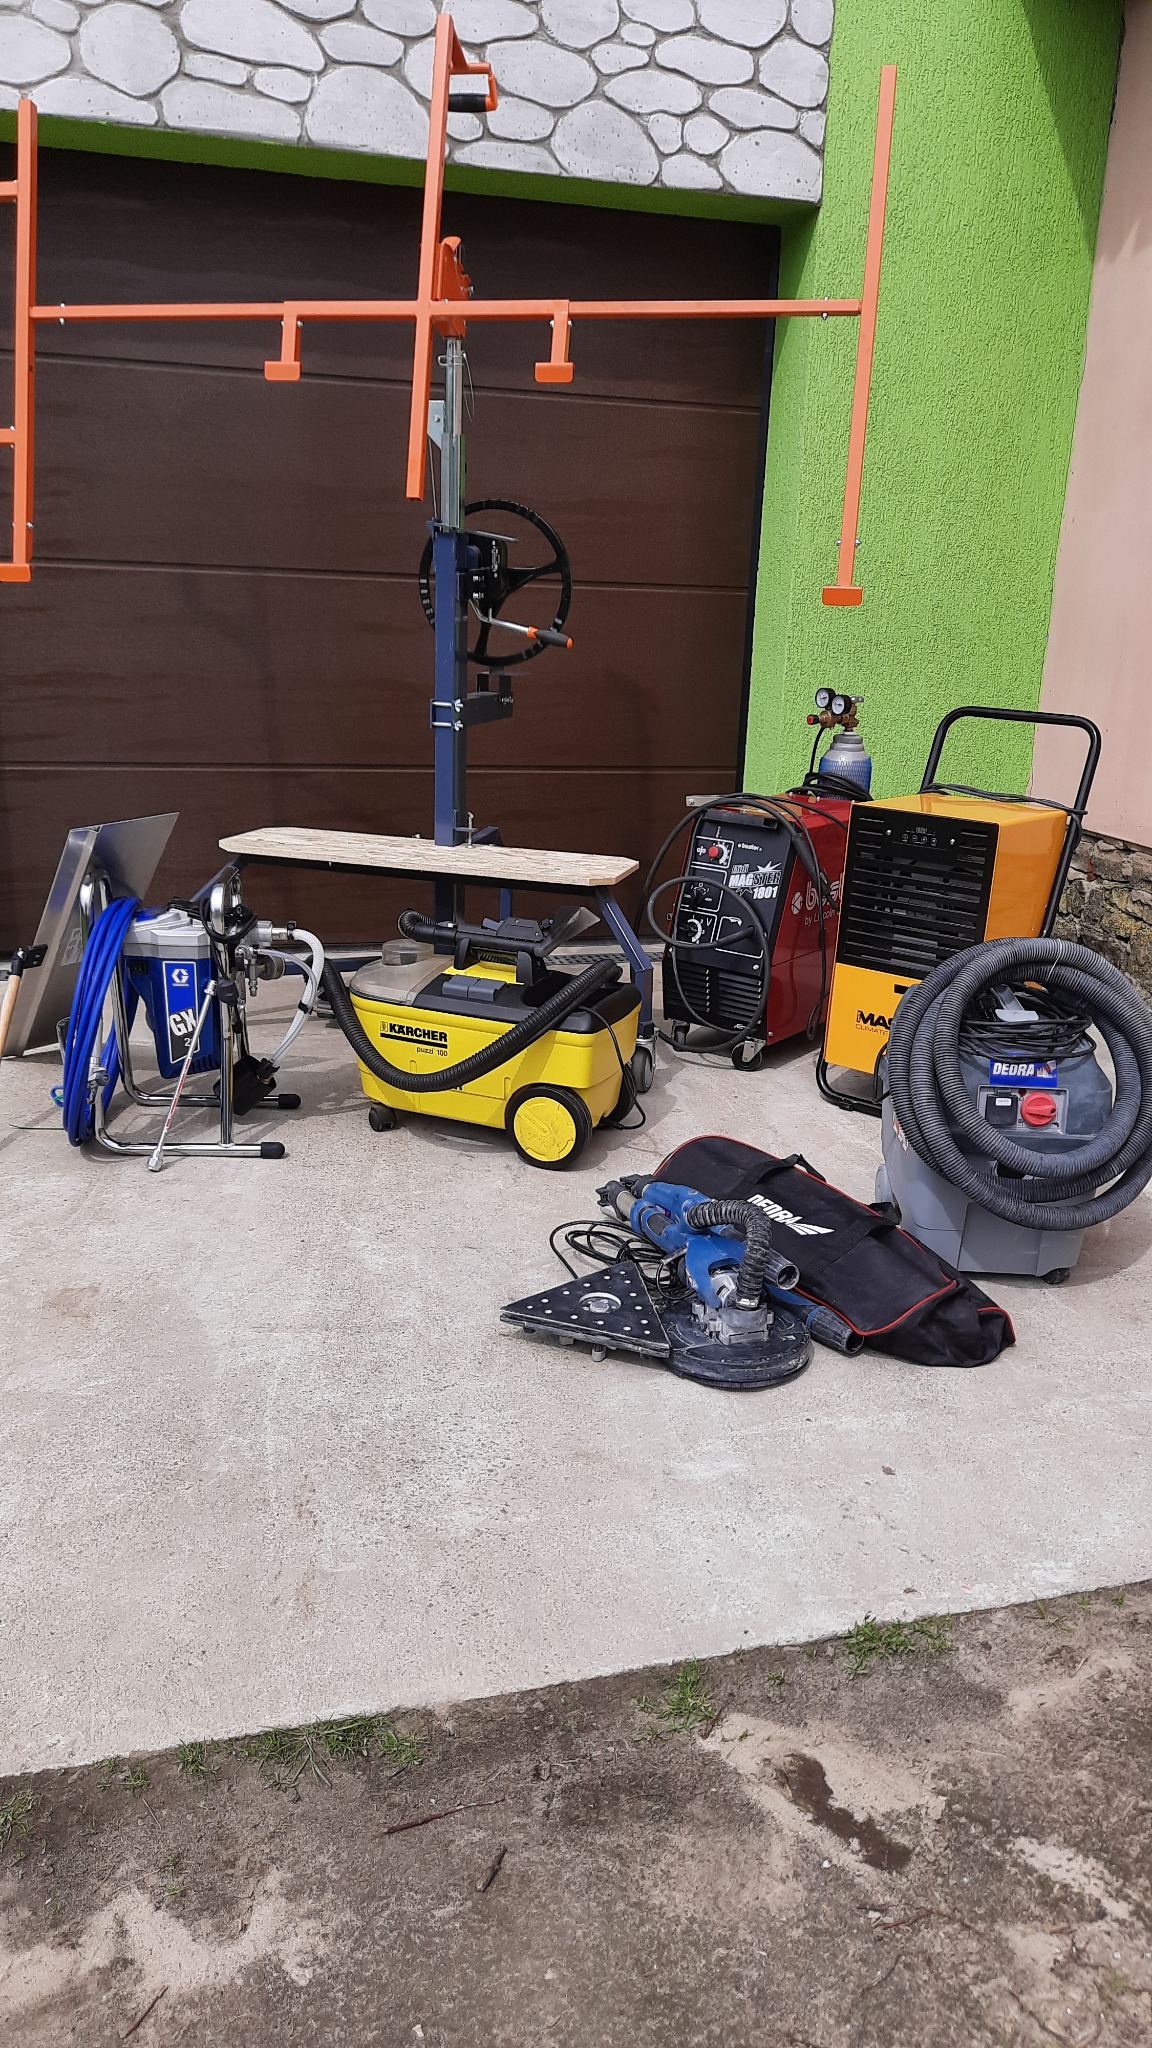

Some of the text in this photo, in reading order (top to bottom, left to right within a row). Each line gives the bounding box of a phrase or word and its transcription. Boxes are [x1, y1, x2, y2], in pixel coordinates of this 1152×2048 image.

[729, 872, 781, 888] MAGSTER
[753, 886, 778, 899] 1801
[813, 909, 836, 923] Licoln
[169, 1007, 197, 1036] GX
[389, 1023, 448, 1042] KÄRCHER
[855, 1023, 889, 1036] CLIMATE
[992, 1062, 1035, 1076] DEDRA
